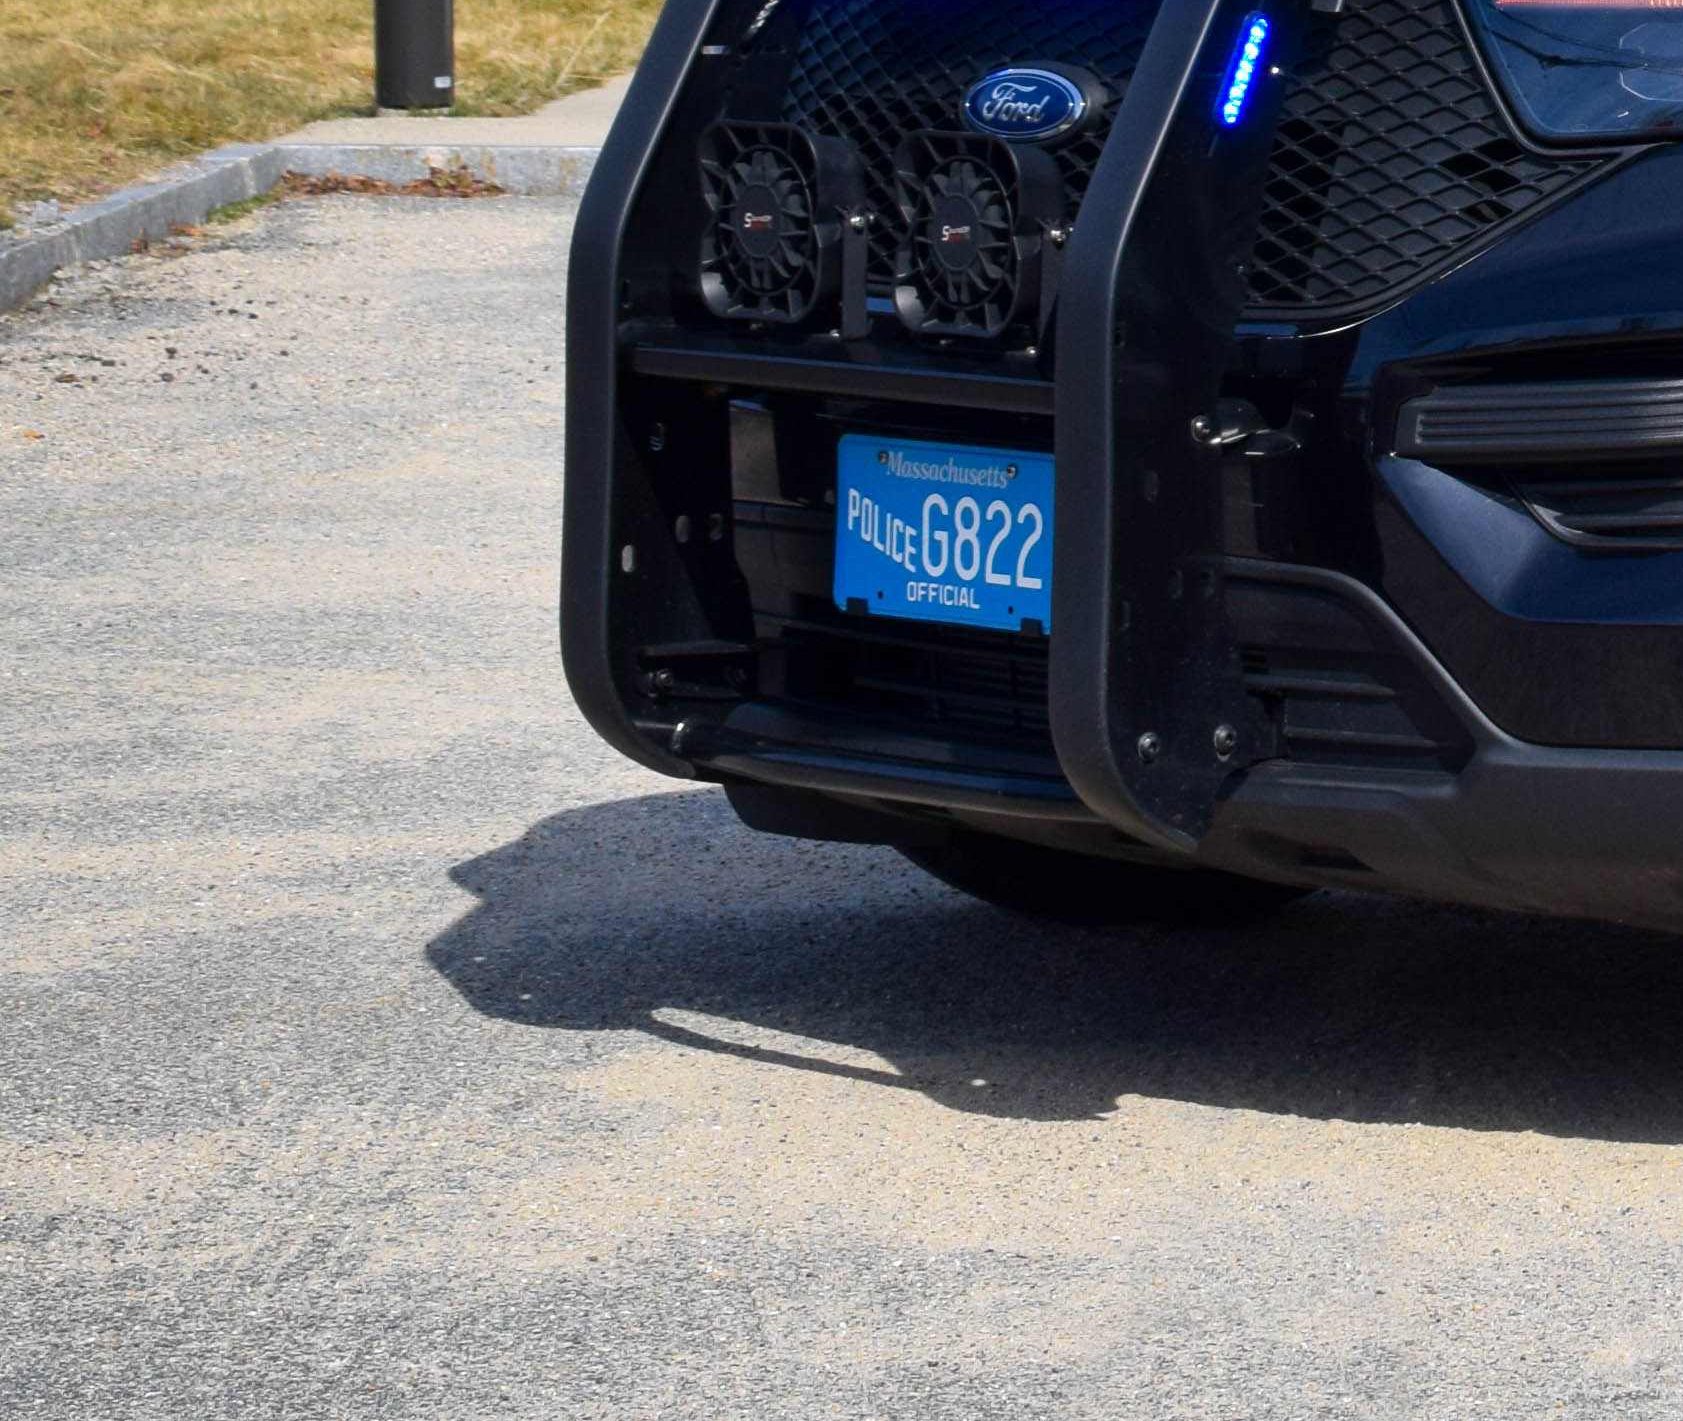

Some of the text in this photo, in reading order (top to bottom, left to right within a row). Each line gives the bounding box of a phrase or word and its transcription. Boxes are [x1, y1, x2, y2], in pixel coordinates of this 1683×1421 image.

[982, 82, 1051, 122] Ford
[887, 451, 1008, 488] Massachusetts
[847, 488, 1043, 589] POLICE G822
[907, 581, 981, 609] OFFICIAL
